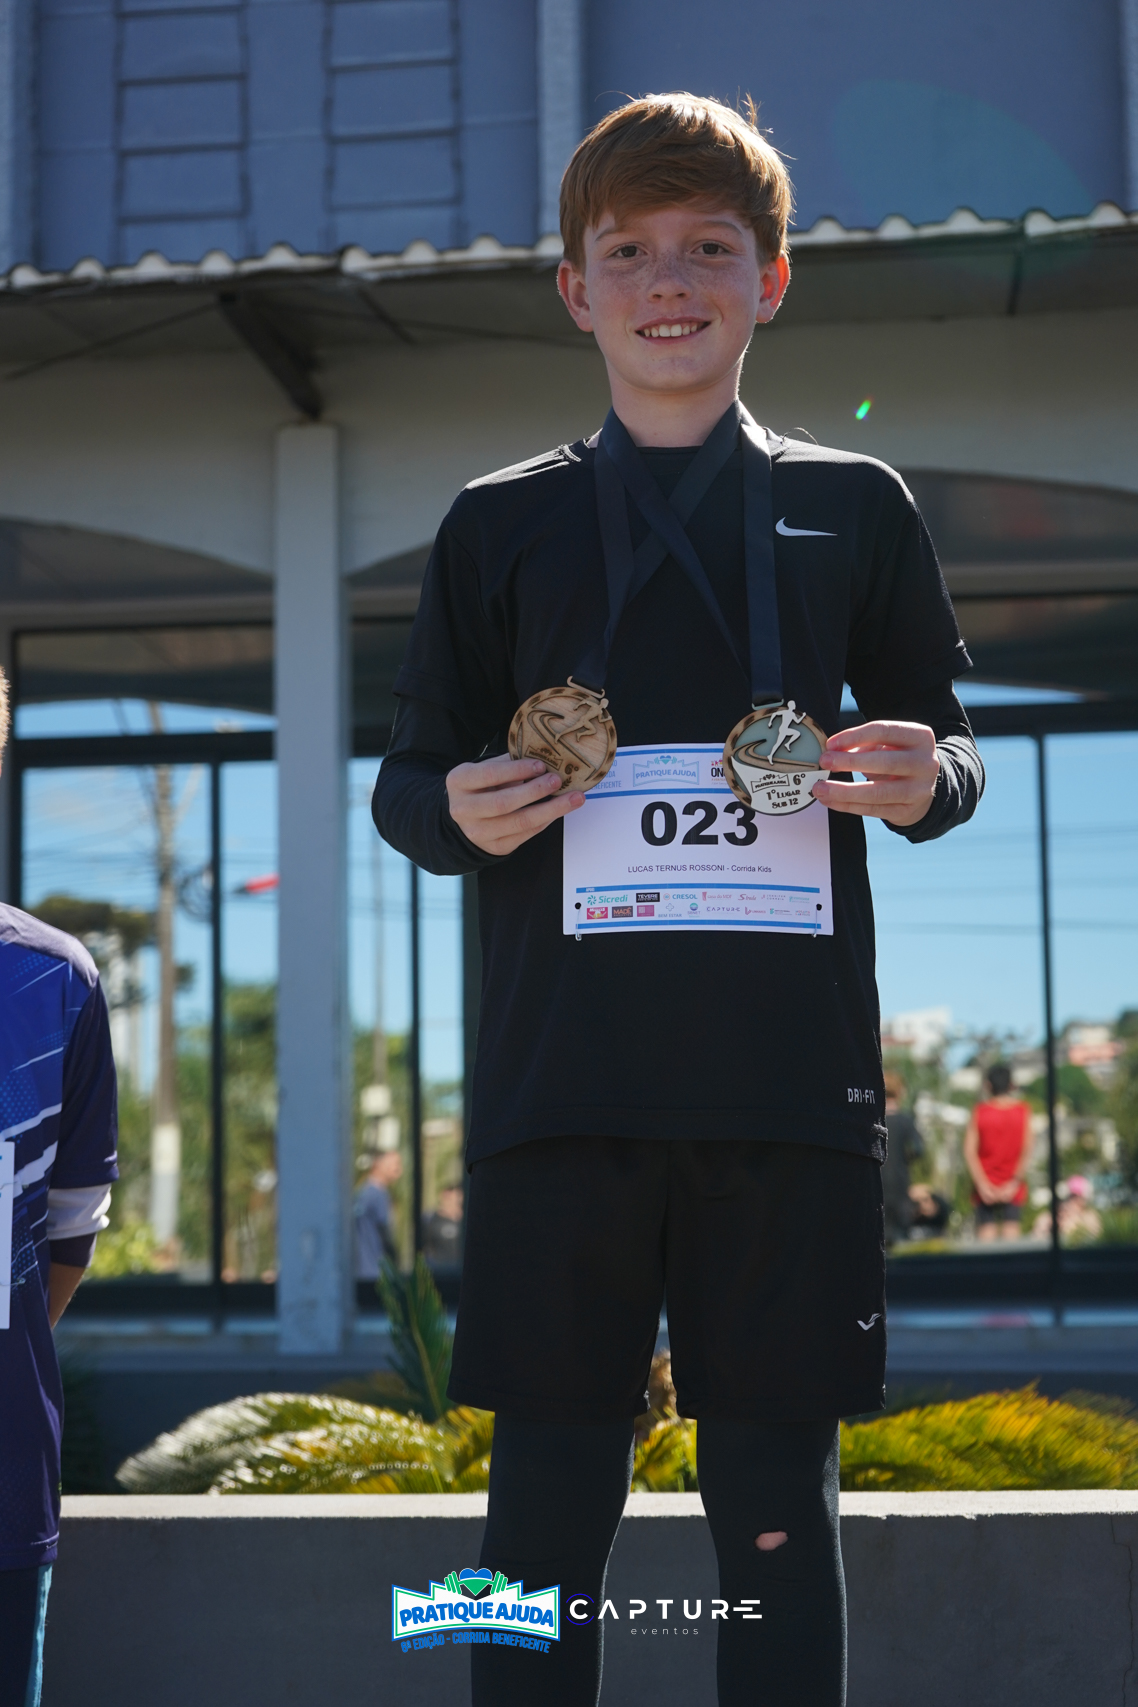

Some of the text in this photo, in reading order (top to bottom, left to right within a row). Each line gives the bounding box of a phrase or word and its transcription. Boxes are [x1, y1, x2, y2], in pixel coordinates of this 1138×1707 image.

[636, 769, 696, 779] PRATIQUE AJUDA
[789, 797, 799, 806] 12
[641, 801, 759, 846] 023
[628, 865, 654, 873] LUCAS
[655, 864, 687, 872] TERNUS
[689, 864, 725, 872] ROSSONI
[731, 864, 756, 873] Corrida
[757, 865, 772, 873] Kids
[598, 894, 628, 904] Sicredi
